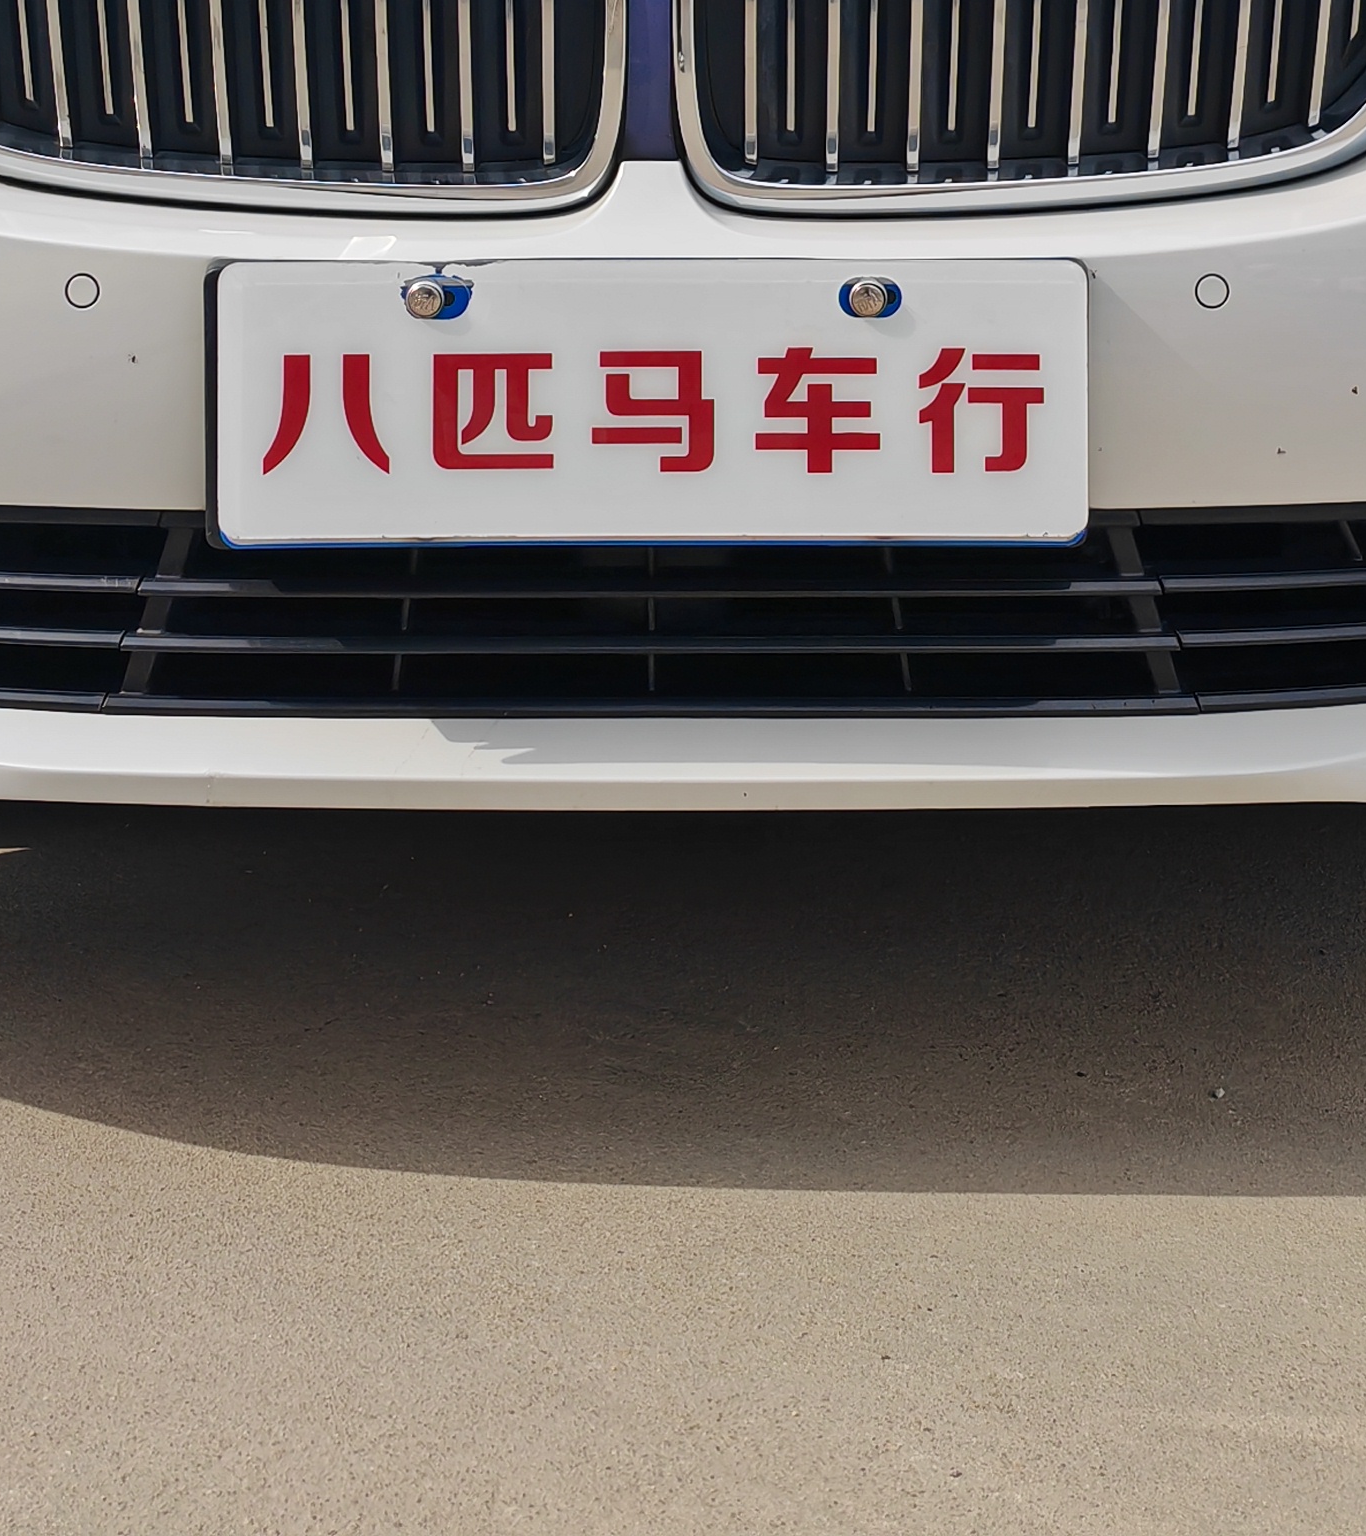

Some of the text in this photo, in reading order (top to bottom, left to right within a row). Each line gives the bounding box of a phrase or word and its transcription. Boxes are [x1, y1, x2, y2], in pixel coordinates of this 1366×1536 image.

[262, 346, 1046, 475] 八匹马车行
